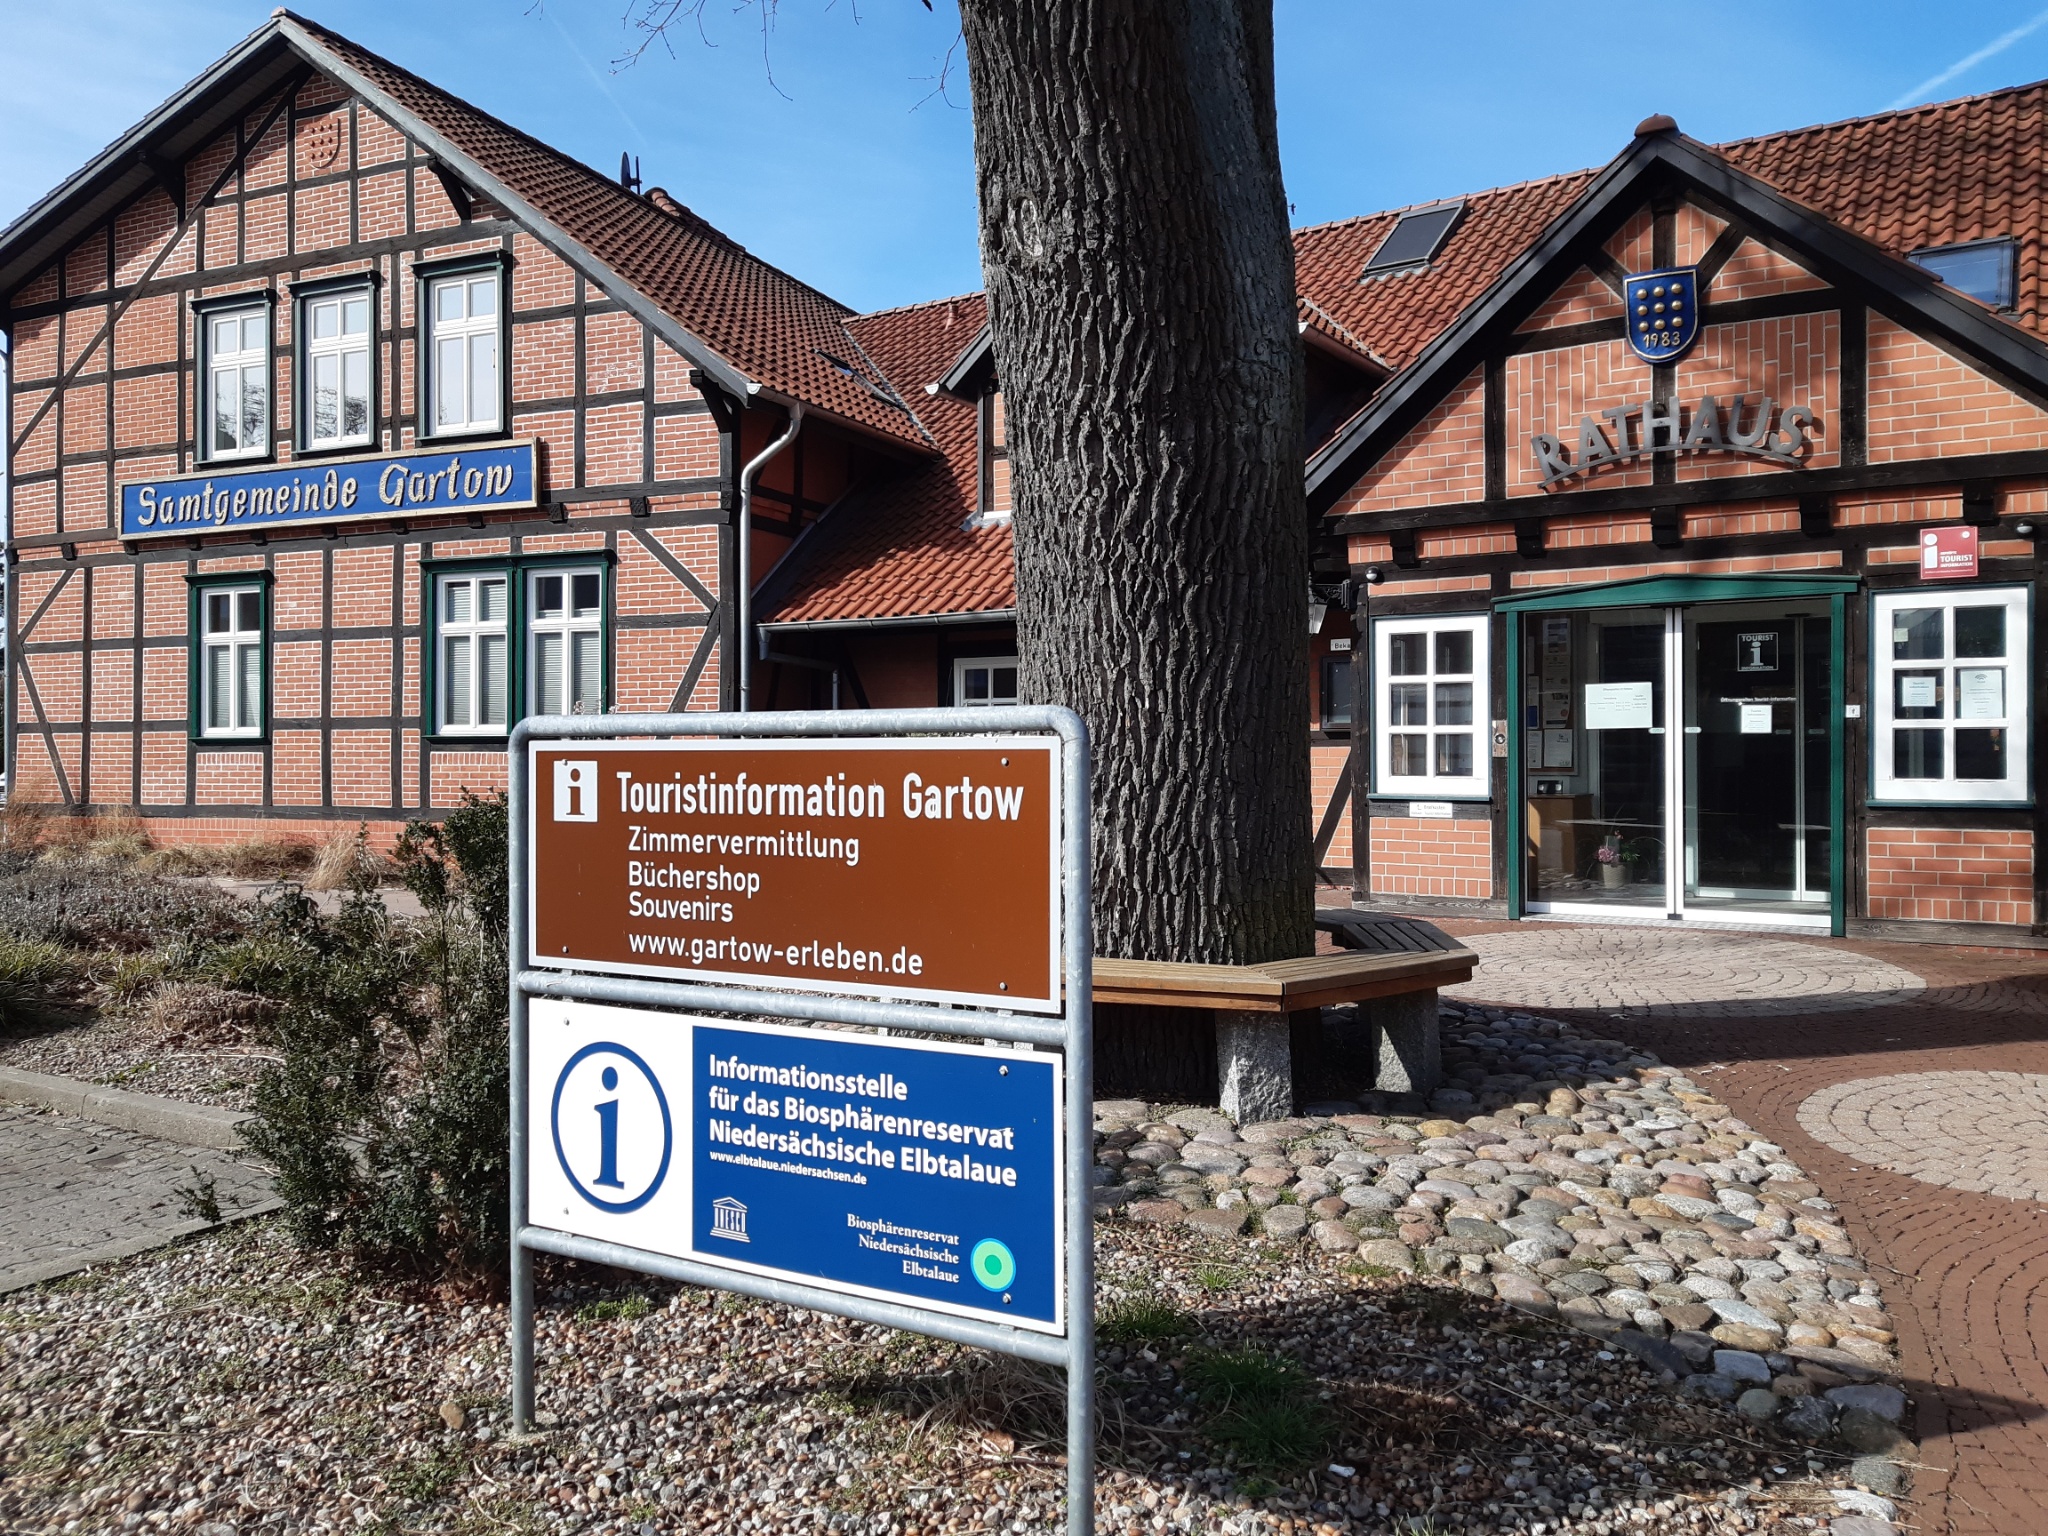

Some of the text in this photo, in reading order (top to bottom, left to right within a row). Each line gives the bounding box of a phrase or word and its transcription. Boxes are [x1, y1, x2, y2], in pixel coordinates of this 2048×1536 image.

[1642, 331, 1681, 349] 1983
[1531, 394, 1814, 484] RATHAUS
[137, 456, 513, 527] Samtgemeinde Gartow
[1940, 554, 1973, 563] TOURIST
[1741, 634, 1774, 642] TOURIST
[616, 771, 1025, 821] Touristinformation Gartow
[628, 825, 860, 867] Zimmervermittlung
[628, 860, 760, 899] Büchershop
[628, 890, 734, 923] Souvenirs
[628, 933, 923, 976] www.gartow-erleben.de
[709, 1053, 908, 1101] Informationsstelle
[708, 1085, 1015, 1151] für das Biosphärenreservat
[709, 1118, 1018, 1188] Niedersächsische Elbtalaue
[709, 1150, 868, 1186] www.elbtalaue.niedersachsen.de
[847, 1213, 960, 1246] Biosphärenreservat
[858, 1233, 960, 1265] Niedersächsische
[902, 1259, 960, 1284] Elbtalaue
